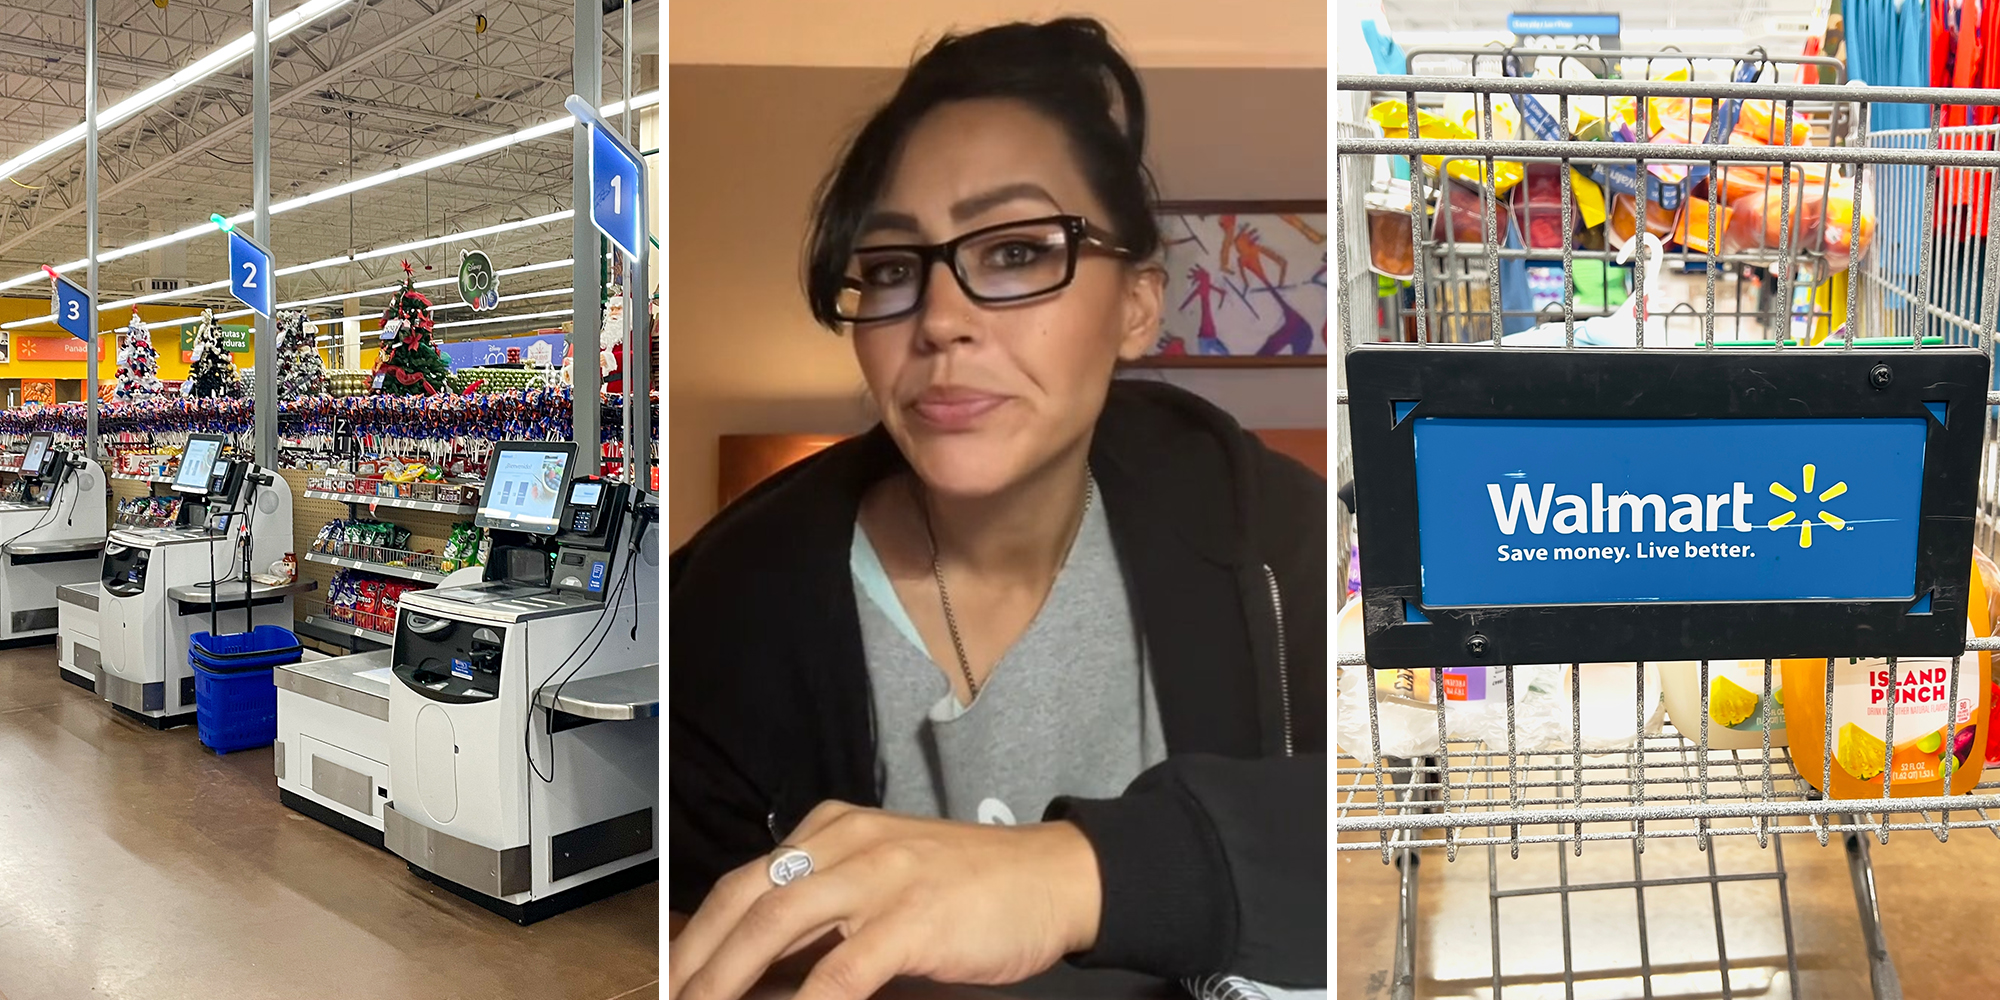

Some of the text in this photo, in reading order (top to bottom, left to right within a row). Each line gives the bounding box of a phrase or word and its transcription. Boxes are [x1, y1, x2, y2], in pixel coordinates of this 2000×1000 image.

[610, 174, 621, 215] 1
[242, 262, 257, 288] 2
[67, 300, 80, 320] 3
[240, 332, 246, 340] y
[1487, 482, 1754, 535] Walmart
[1498, 541, 1755, 563] Save money. Live better.
[1901, 762, 1925, 771] 52 FL OZ
